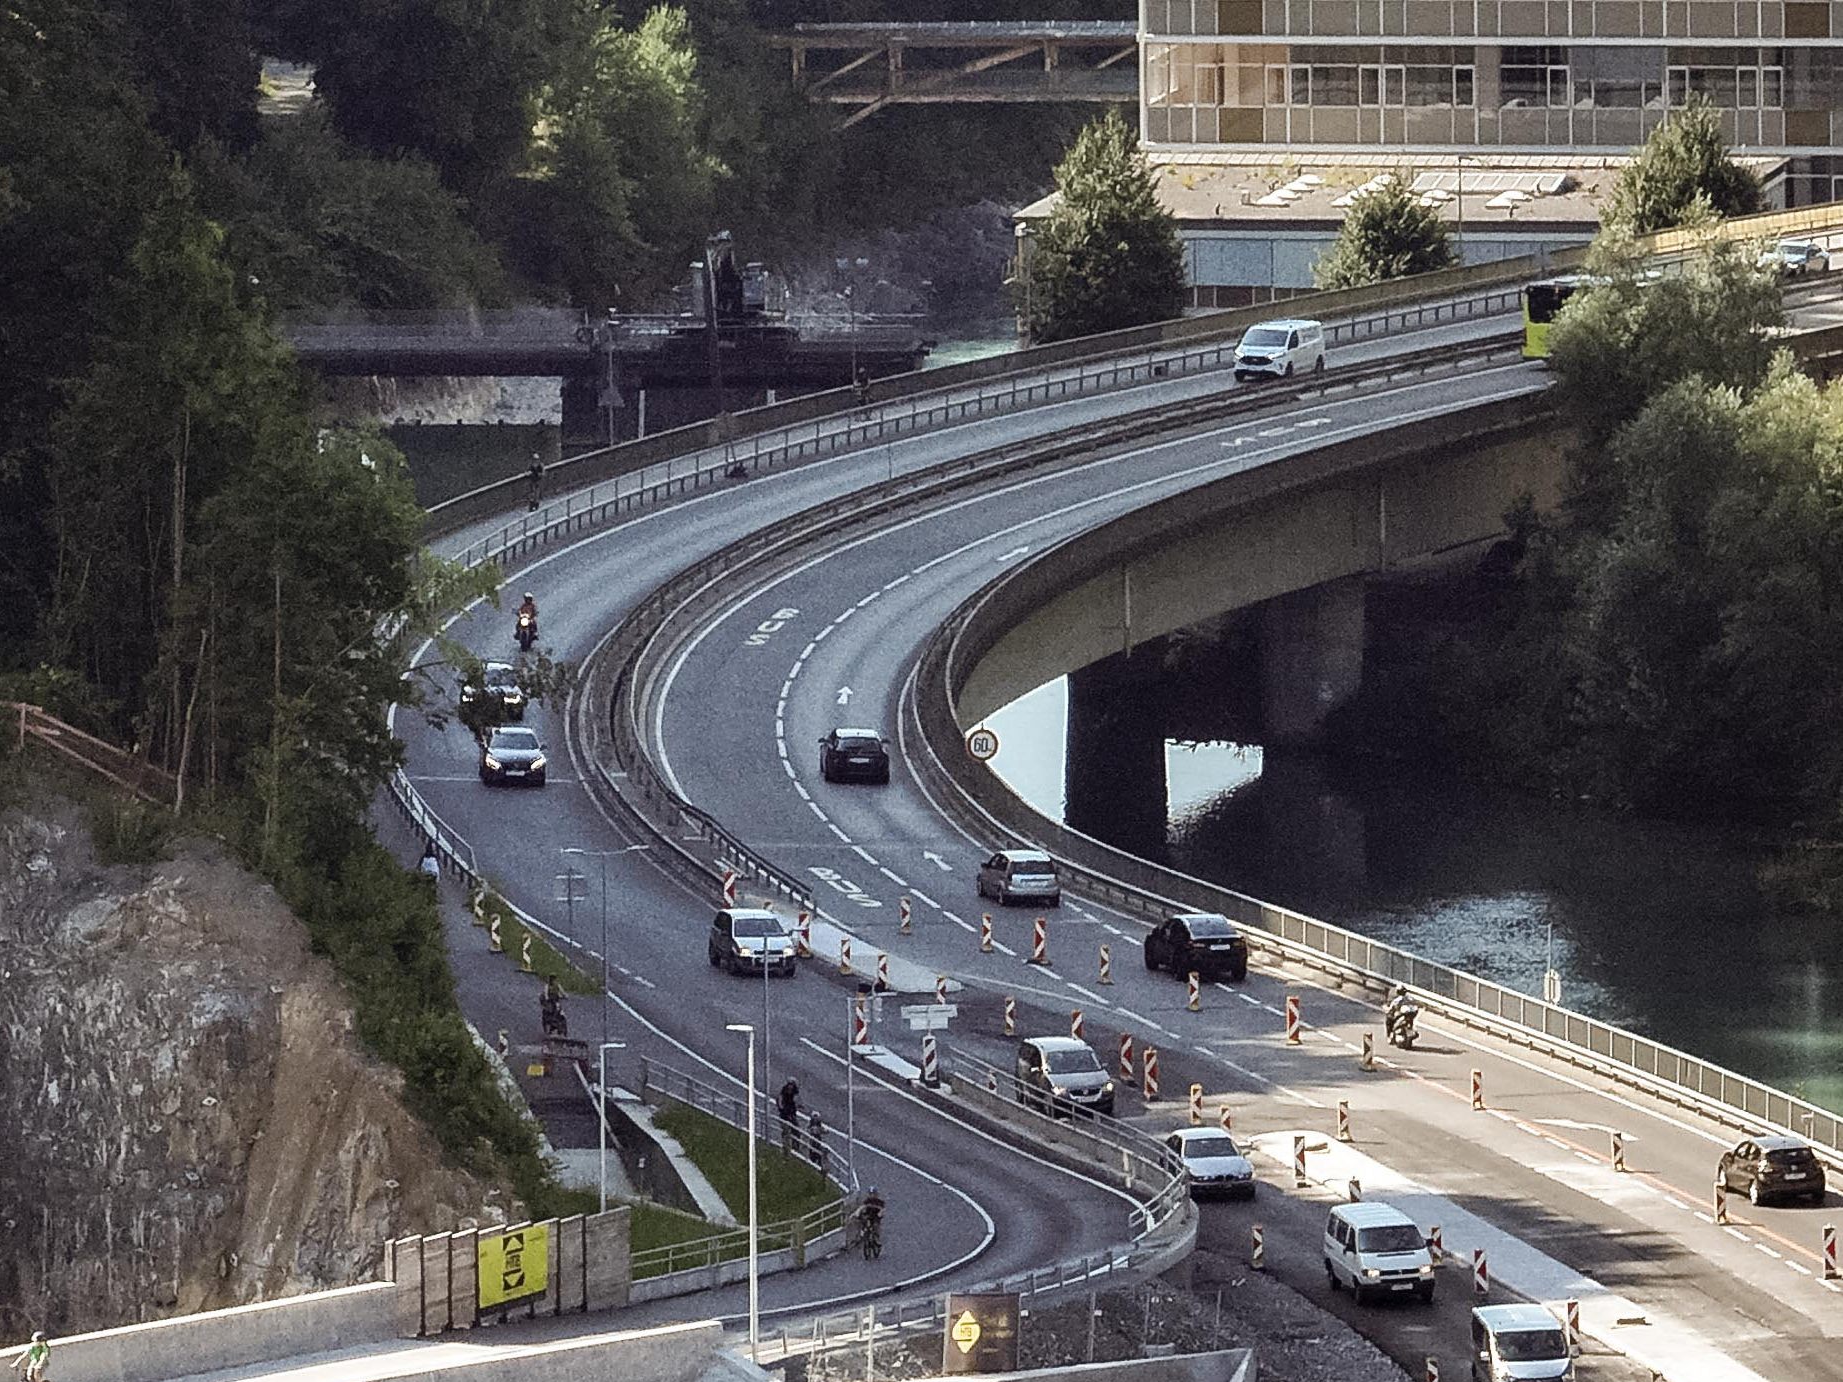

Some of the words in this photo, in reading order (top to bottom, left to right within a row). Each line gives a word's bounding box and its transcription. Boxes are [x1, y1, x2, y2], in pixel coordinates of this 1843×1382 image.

[743, 608, 799, 646] BUS
[974, 738, 988, 752] 60
[807, 867, 882, 907] BUS
